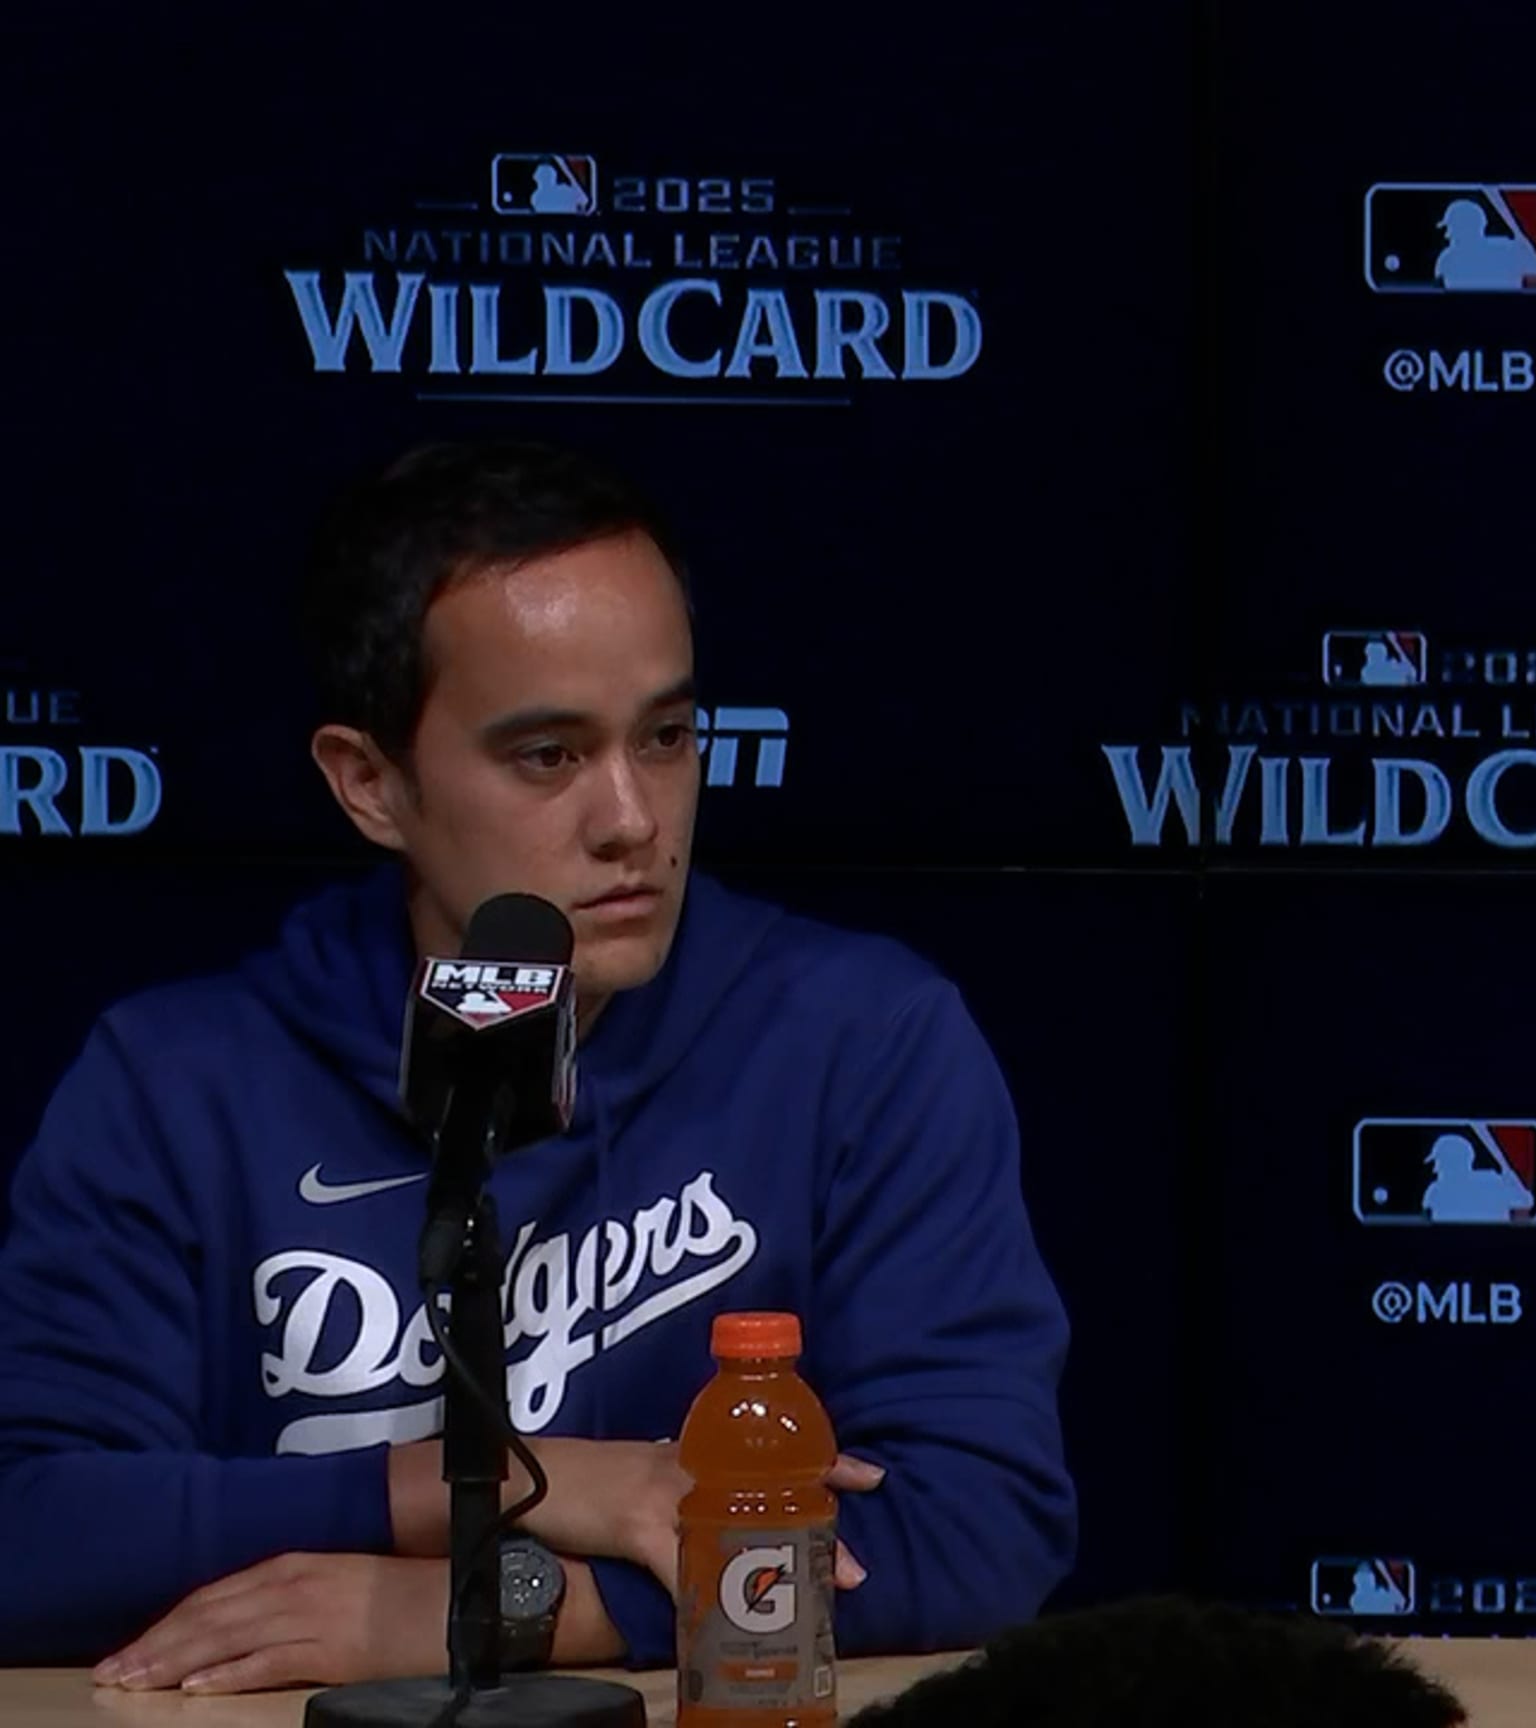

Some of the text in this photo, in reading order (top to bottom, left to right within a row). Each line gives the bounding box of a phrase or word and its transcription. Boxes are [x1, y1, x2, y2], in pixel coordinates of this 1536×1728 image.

[611, 176, 776, 214] 2025
[362, 228, 902, 271] NATIONAL LEAGUE
[283, 268, 984, 380] WILD CARD
[1383, 349, 1536, 393] @MLB
[1181, 701, 1481, 738] NATIONAL
[0, 744, 162, 837] RD
[433, 963, 555, 987] MLB
[1371, 1280, 1524, 1325] @MLB
[719, 1544, 797, 1634] G
